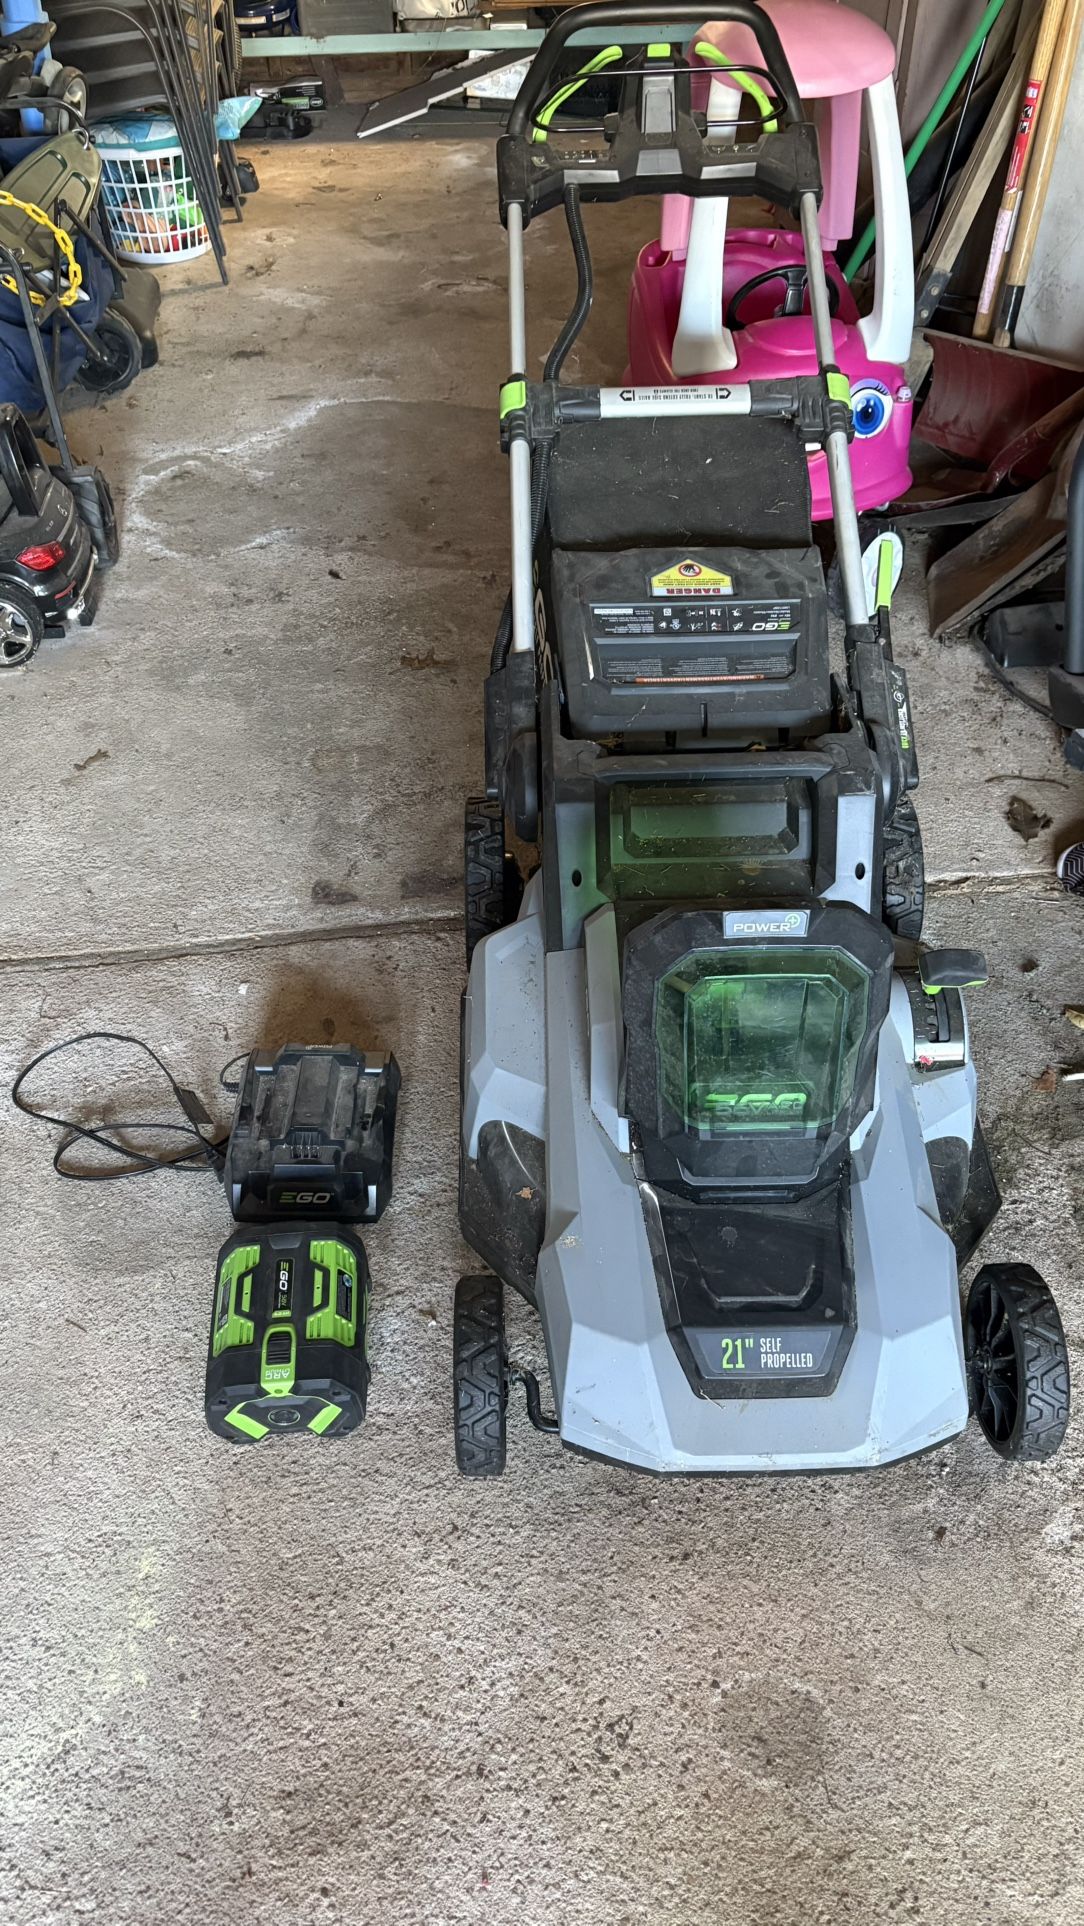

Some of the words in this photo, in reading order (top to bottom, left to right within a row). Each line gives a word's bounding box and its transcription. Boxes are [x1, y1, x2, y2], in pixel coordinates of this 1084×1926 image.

[666, 587, 721, 595] DANGER
[752, 621, 791, 631] EGO
[279, 1191, 331, 1204] EGO
[279, 1261, 289, 1291] EGO
[721, 1337, 754, 1369] 21"
[759, 1337, 782, 1353] SELF
[760, 1353, 813, 1369] PROPELLED
